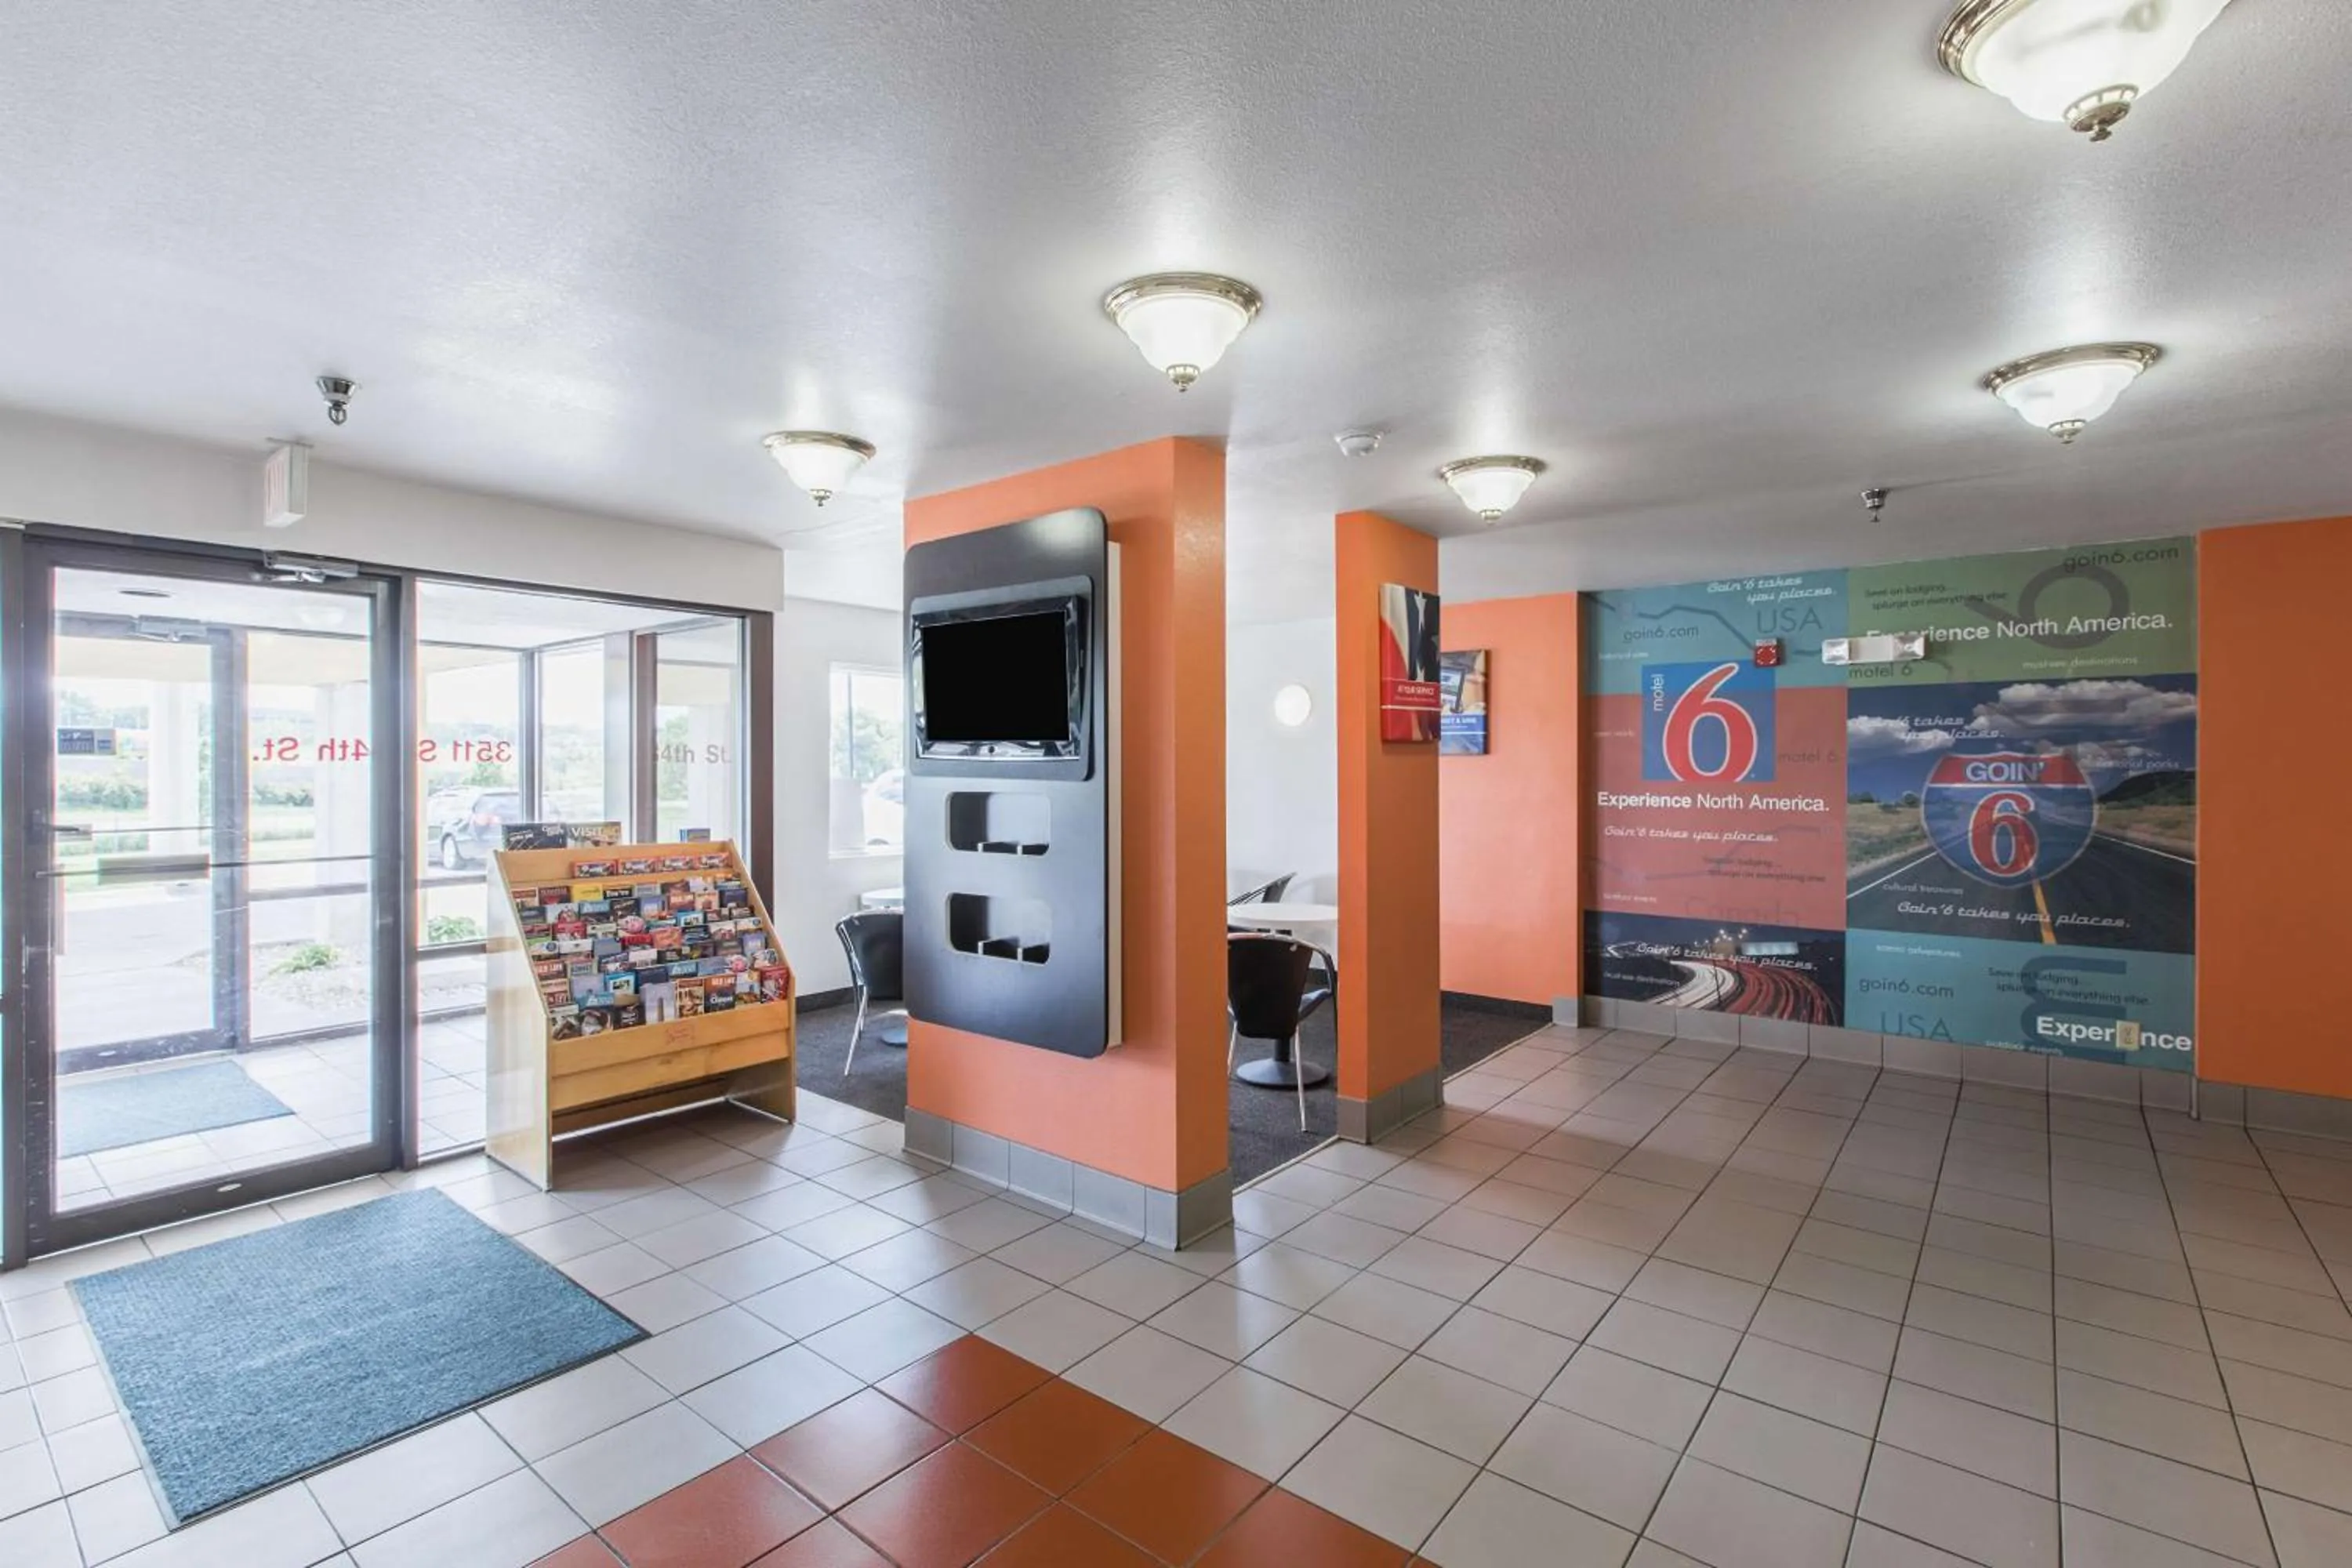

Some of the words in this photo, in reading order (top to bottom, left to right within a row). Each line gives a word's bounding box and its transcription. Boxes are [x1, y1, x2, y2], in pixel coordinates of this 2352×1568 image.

[2063, 547, 2179, 573] goin6.com
[1758, 576, 1802, 589] takes
[1747, 592, 1775, 605] you
[1758, 607, 1823, 633] USA
[1997, 618, 2058, 638] North
[2066, 612, 2173, 634] America.
[1623, 626, 1699, 644] goin6.com
[1849, 662, 1893, 678] motel
[1901, 662, 1913, 677] 6
[1650, 673, 1664, 711] motel
[1662, 662, 1759, 782] 6
[1965, 760, 2045, 782] GOIN'
[1597, 792, 1692, 810] Experience
[1697, 794, 1744, 809] North
[1749, 794, 1830, 812] America.
[1649, 828, 1688, 839] takes
[1693, 832, 1720, 844] you
[1968, 790, 2038, 877] 6
[1958, 907, 2010, 920] takes
[2016, 912, 2052, 924] you
[2055, 913, 2131, 927] places.
[1684, 949, 1724, 960] takes
[1729, 954, 1756, 966] you
[1860, 978, 1955, 998] goin6.com
[1881, 1011, 1955, 1043] USA
[2036, 1015, 2193, 1052] Expernce
